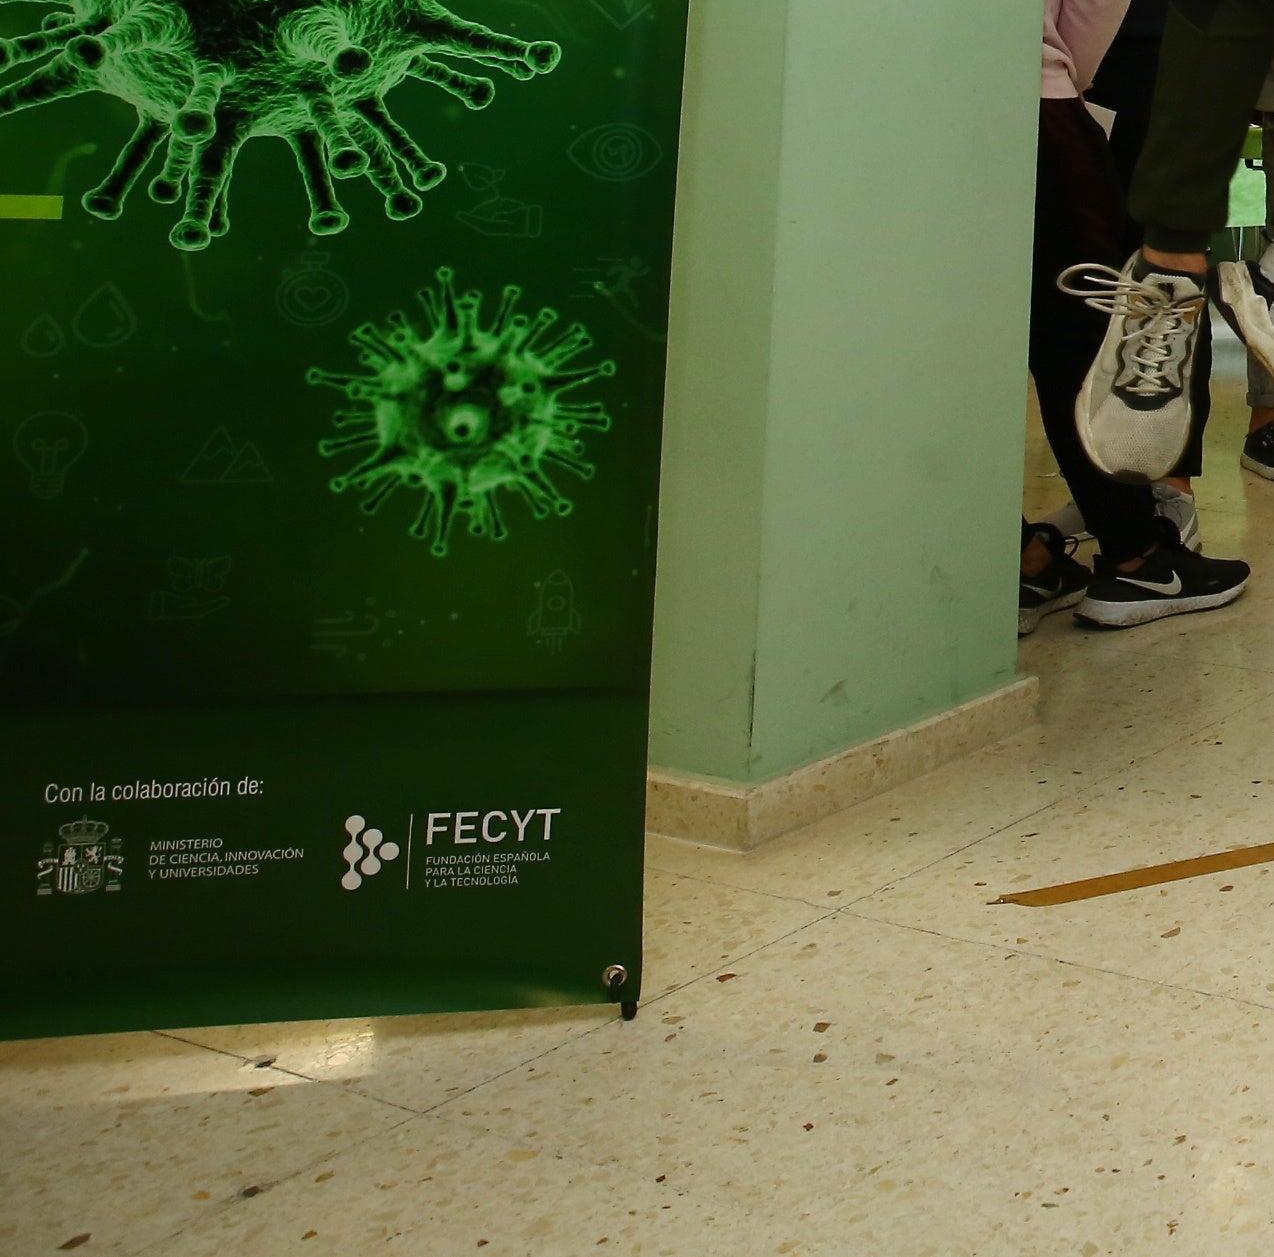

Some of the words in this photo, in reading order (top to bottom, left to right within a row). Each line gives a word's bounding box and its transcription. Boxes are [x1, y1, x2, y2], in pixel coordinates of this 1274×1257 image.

[44, 783, 83, 803] Con
[90, 782, 106, 801] la
[112, 777, 231, 800] colaboración
[237, 776, 264, 795] de:
[426, 808, 562, 845] FECYT
[150, 838, 223, 851] MINISTERIO
[149, 854, 168, 865] DE
[169, 852, 223, 864] CIENCIA,
[224, 847, 304, 862] INNOVACIÓN
[426, 853, 490, 865] FUNDACIÓN
[493, 851, 550, 863] ESPAÑOLA
[148, 869, 157, 879] Y
[159, 864, 259, 879] UNIVERSIDADES
[425, 867, 454, 876] PARA
[457, 866, 471, 875] LA
[474, 865, 517, 874] CIENCIA
[425, 879, 431, 887] Y
[434, 878, 447, 887] LA
[451, 875, 518, 887] TECNOLOGÍA
